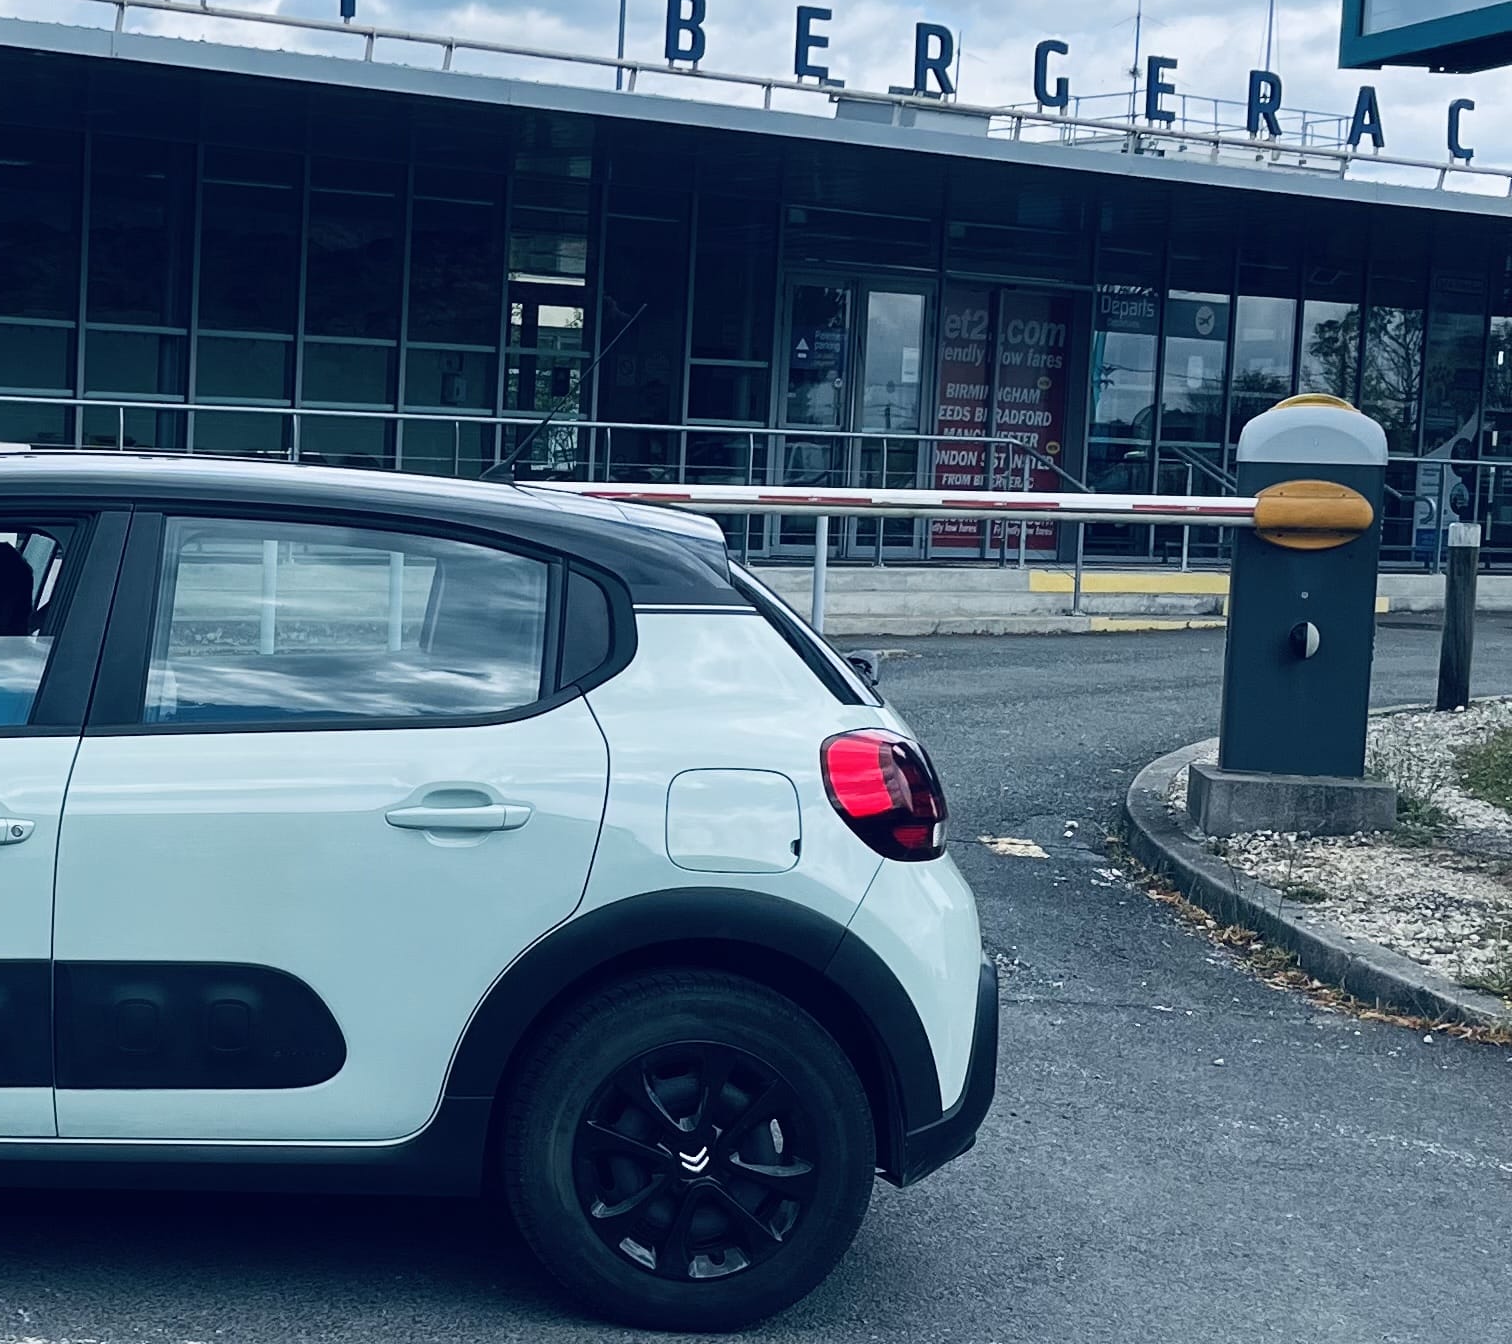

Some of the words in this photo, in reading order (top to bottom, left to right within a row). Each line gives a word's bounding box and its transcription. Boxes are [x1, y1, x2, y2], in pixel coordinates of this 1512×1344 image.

[944, 308, 1066, 348] et2.com
[1027, 348, 1063, 369] fares
[938, 405, 971, 422] EEDS
[935, 450, 978, 467] ONDON
